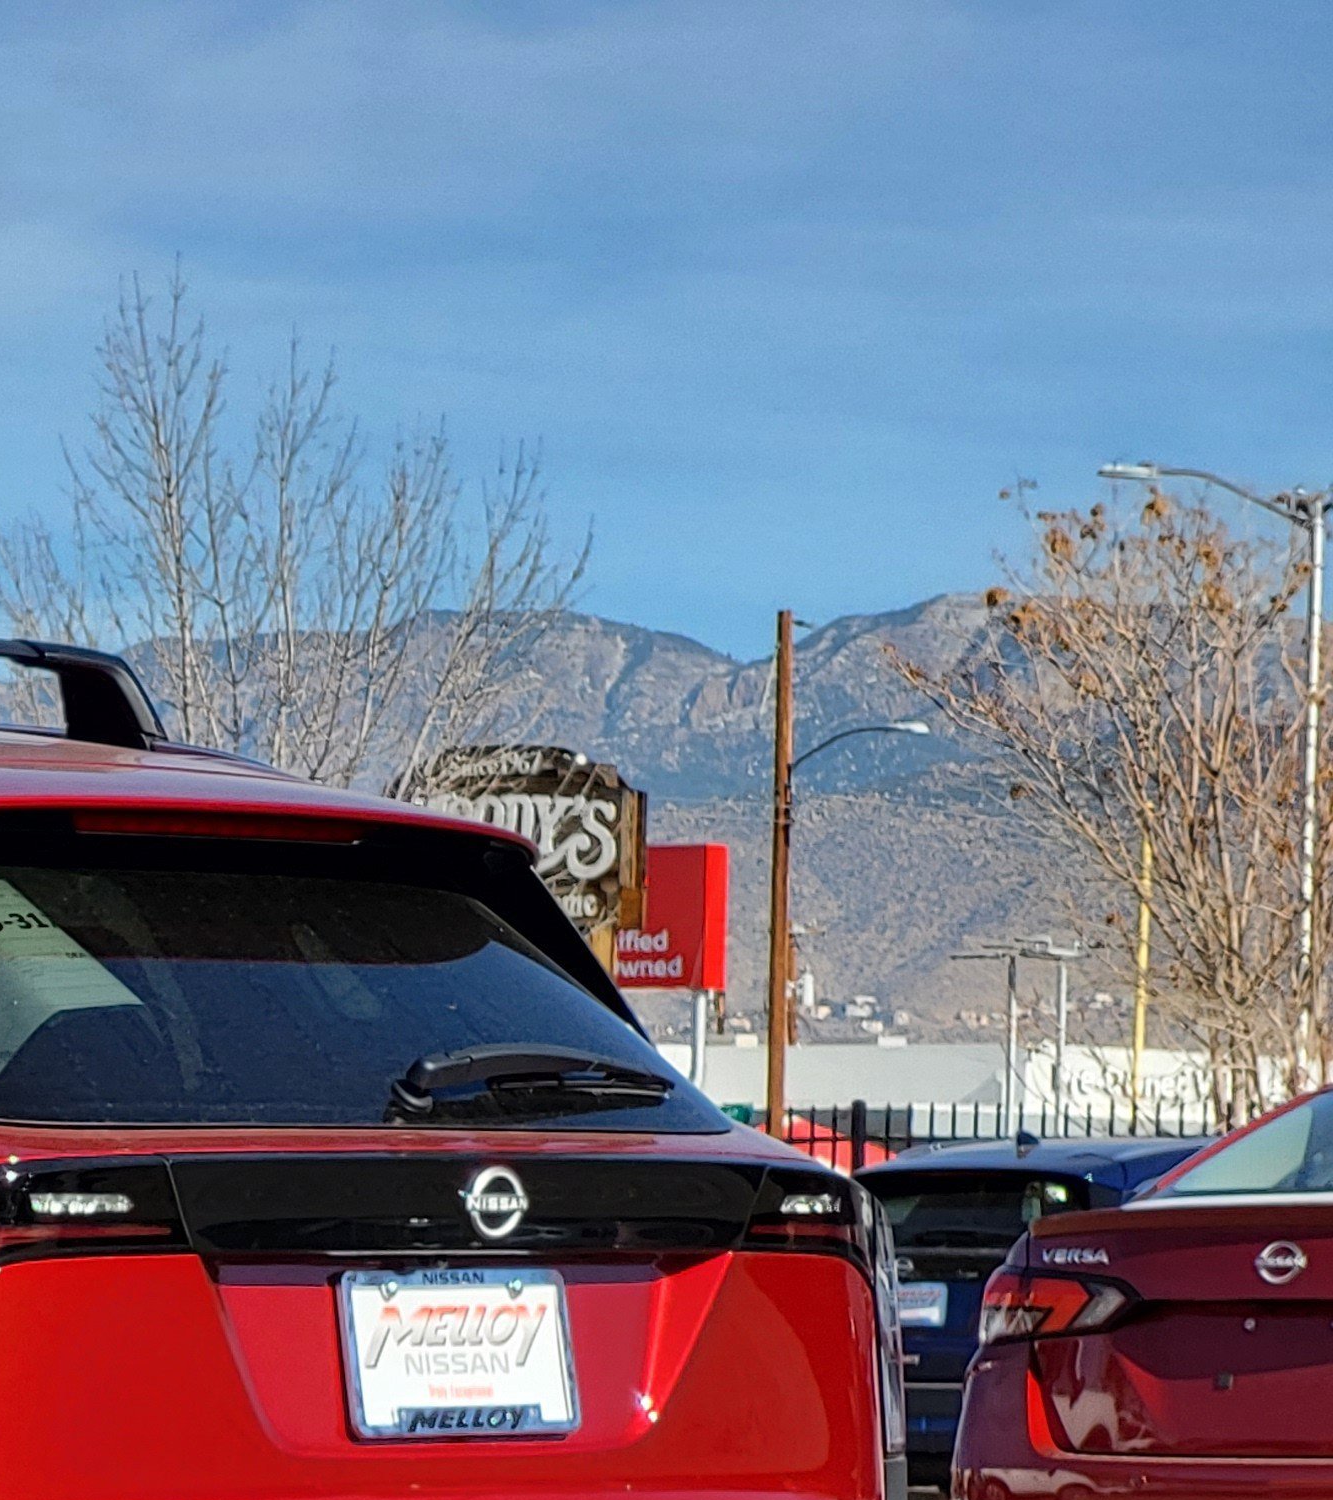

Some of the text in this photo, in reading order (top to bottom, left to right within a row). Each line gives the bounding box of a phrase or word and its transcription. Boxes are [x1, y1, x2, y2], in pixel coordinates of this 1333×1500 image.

[499, 750, 543, 776] 1967
[467, 1195, 528, 1211] NISSAN
[1042, 1248, 1110, 1265] VERSA
[422, 1272, 484, 1285] NISSAN
[365, 1304, 547, 1368] MELLOY
[405, 1353, 510, 1376] NISSAN
[408, 1408, 523, 1432] MELLOY
